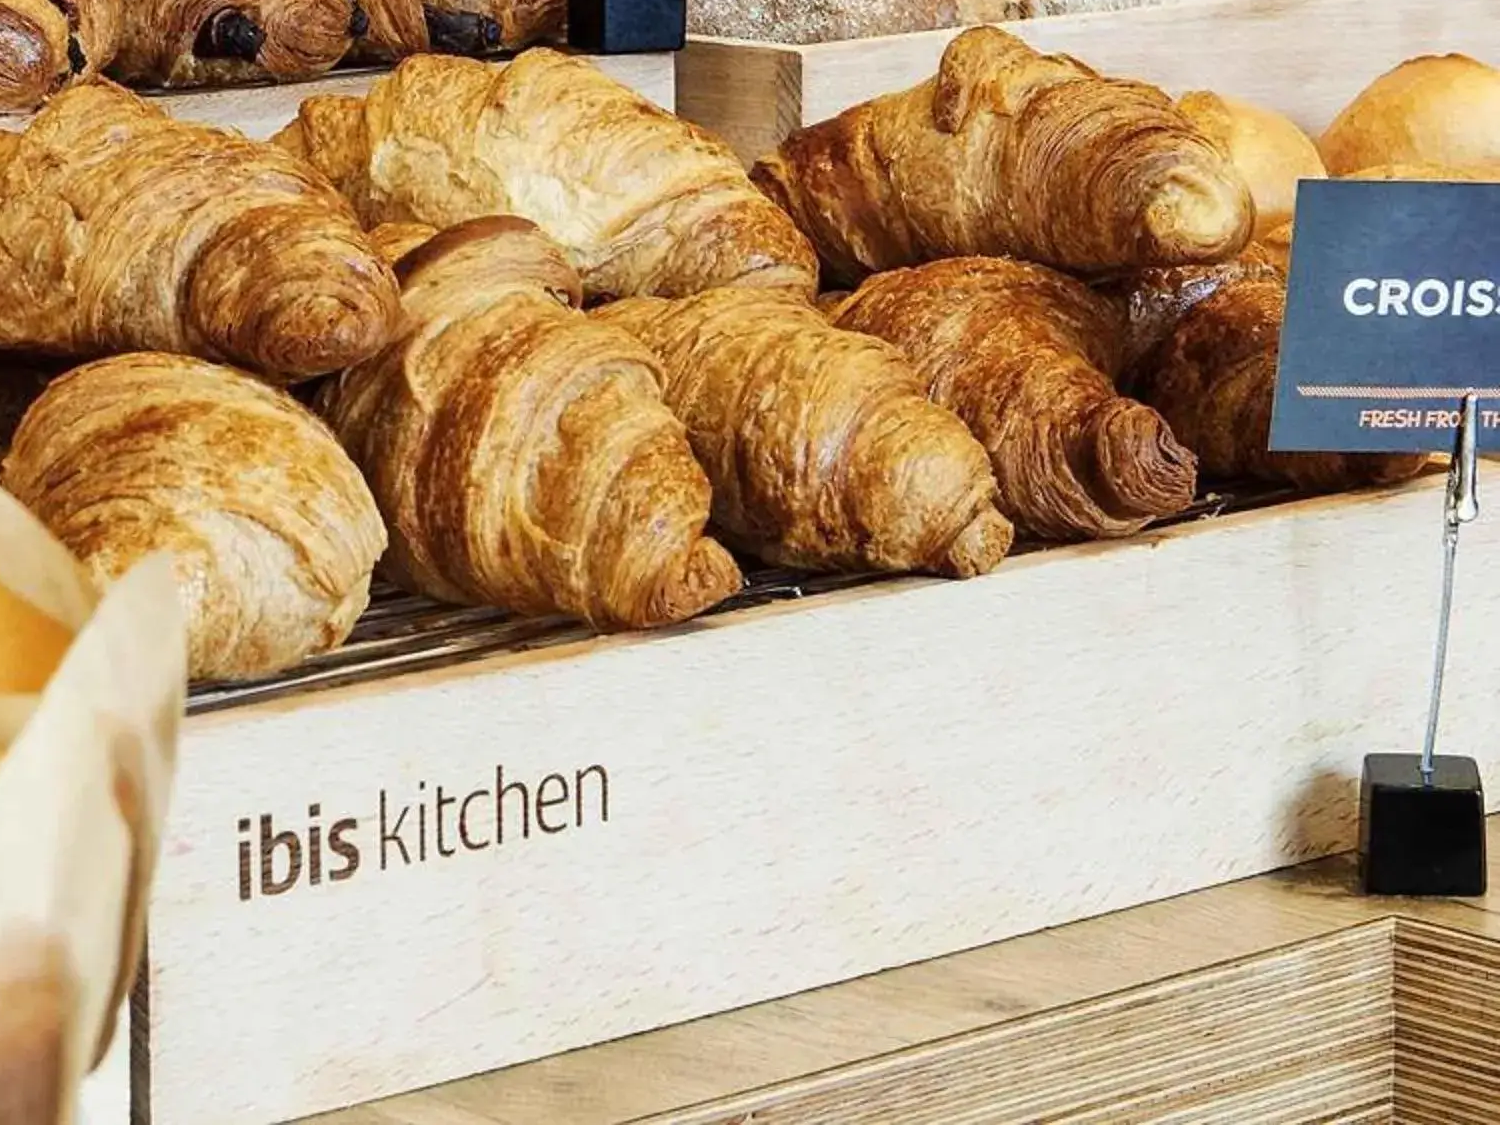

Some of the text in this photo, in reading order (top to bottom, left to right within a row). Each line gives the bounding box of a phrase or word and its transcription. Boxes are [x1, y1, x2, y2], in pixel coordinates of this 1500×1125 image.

[1343, 278, 1500, 316] CROIS
[1359, 409, 1420, 428] FRESH
[1424, 410, 1463, 428] FRO
[237, 764, 609, 901] ibis kitchen
